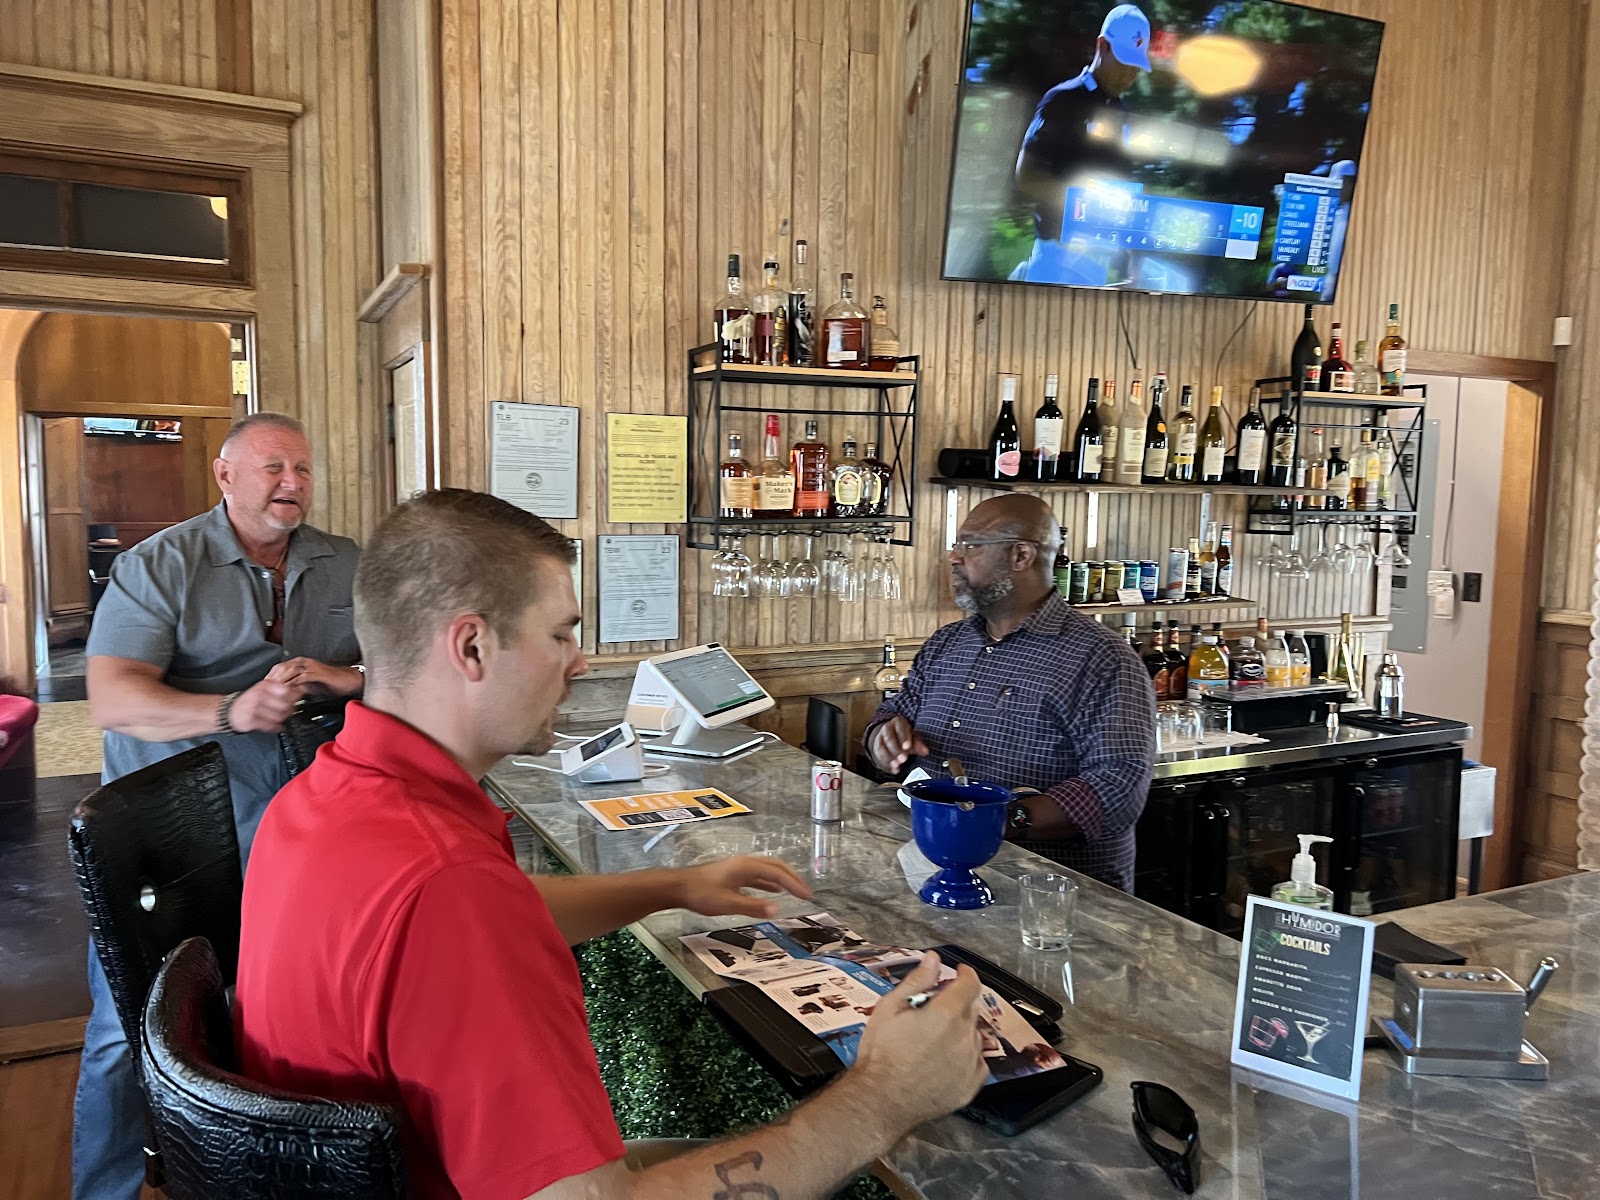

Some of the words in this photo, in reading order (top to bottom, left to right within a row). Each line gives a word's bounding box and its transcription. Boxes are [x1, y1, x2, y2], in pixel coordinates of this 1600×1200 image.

[1128, 198, 1150, 213] KIM
[1235, 212, 1258, 229] -10
[559, 418, 569, 426] 23
[1281, 934, 1330, 955] COCKTAILS
